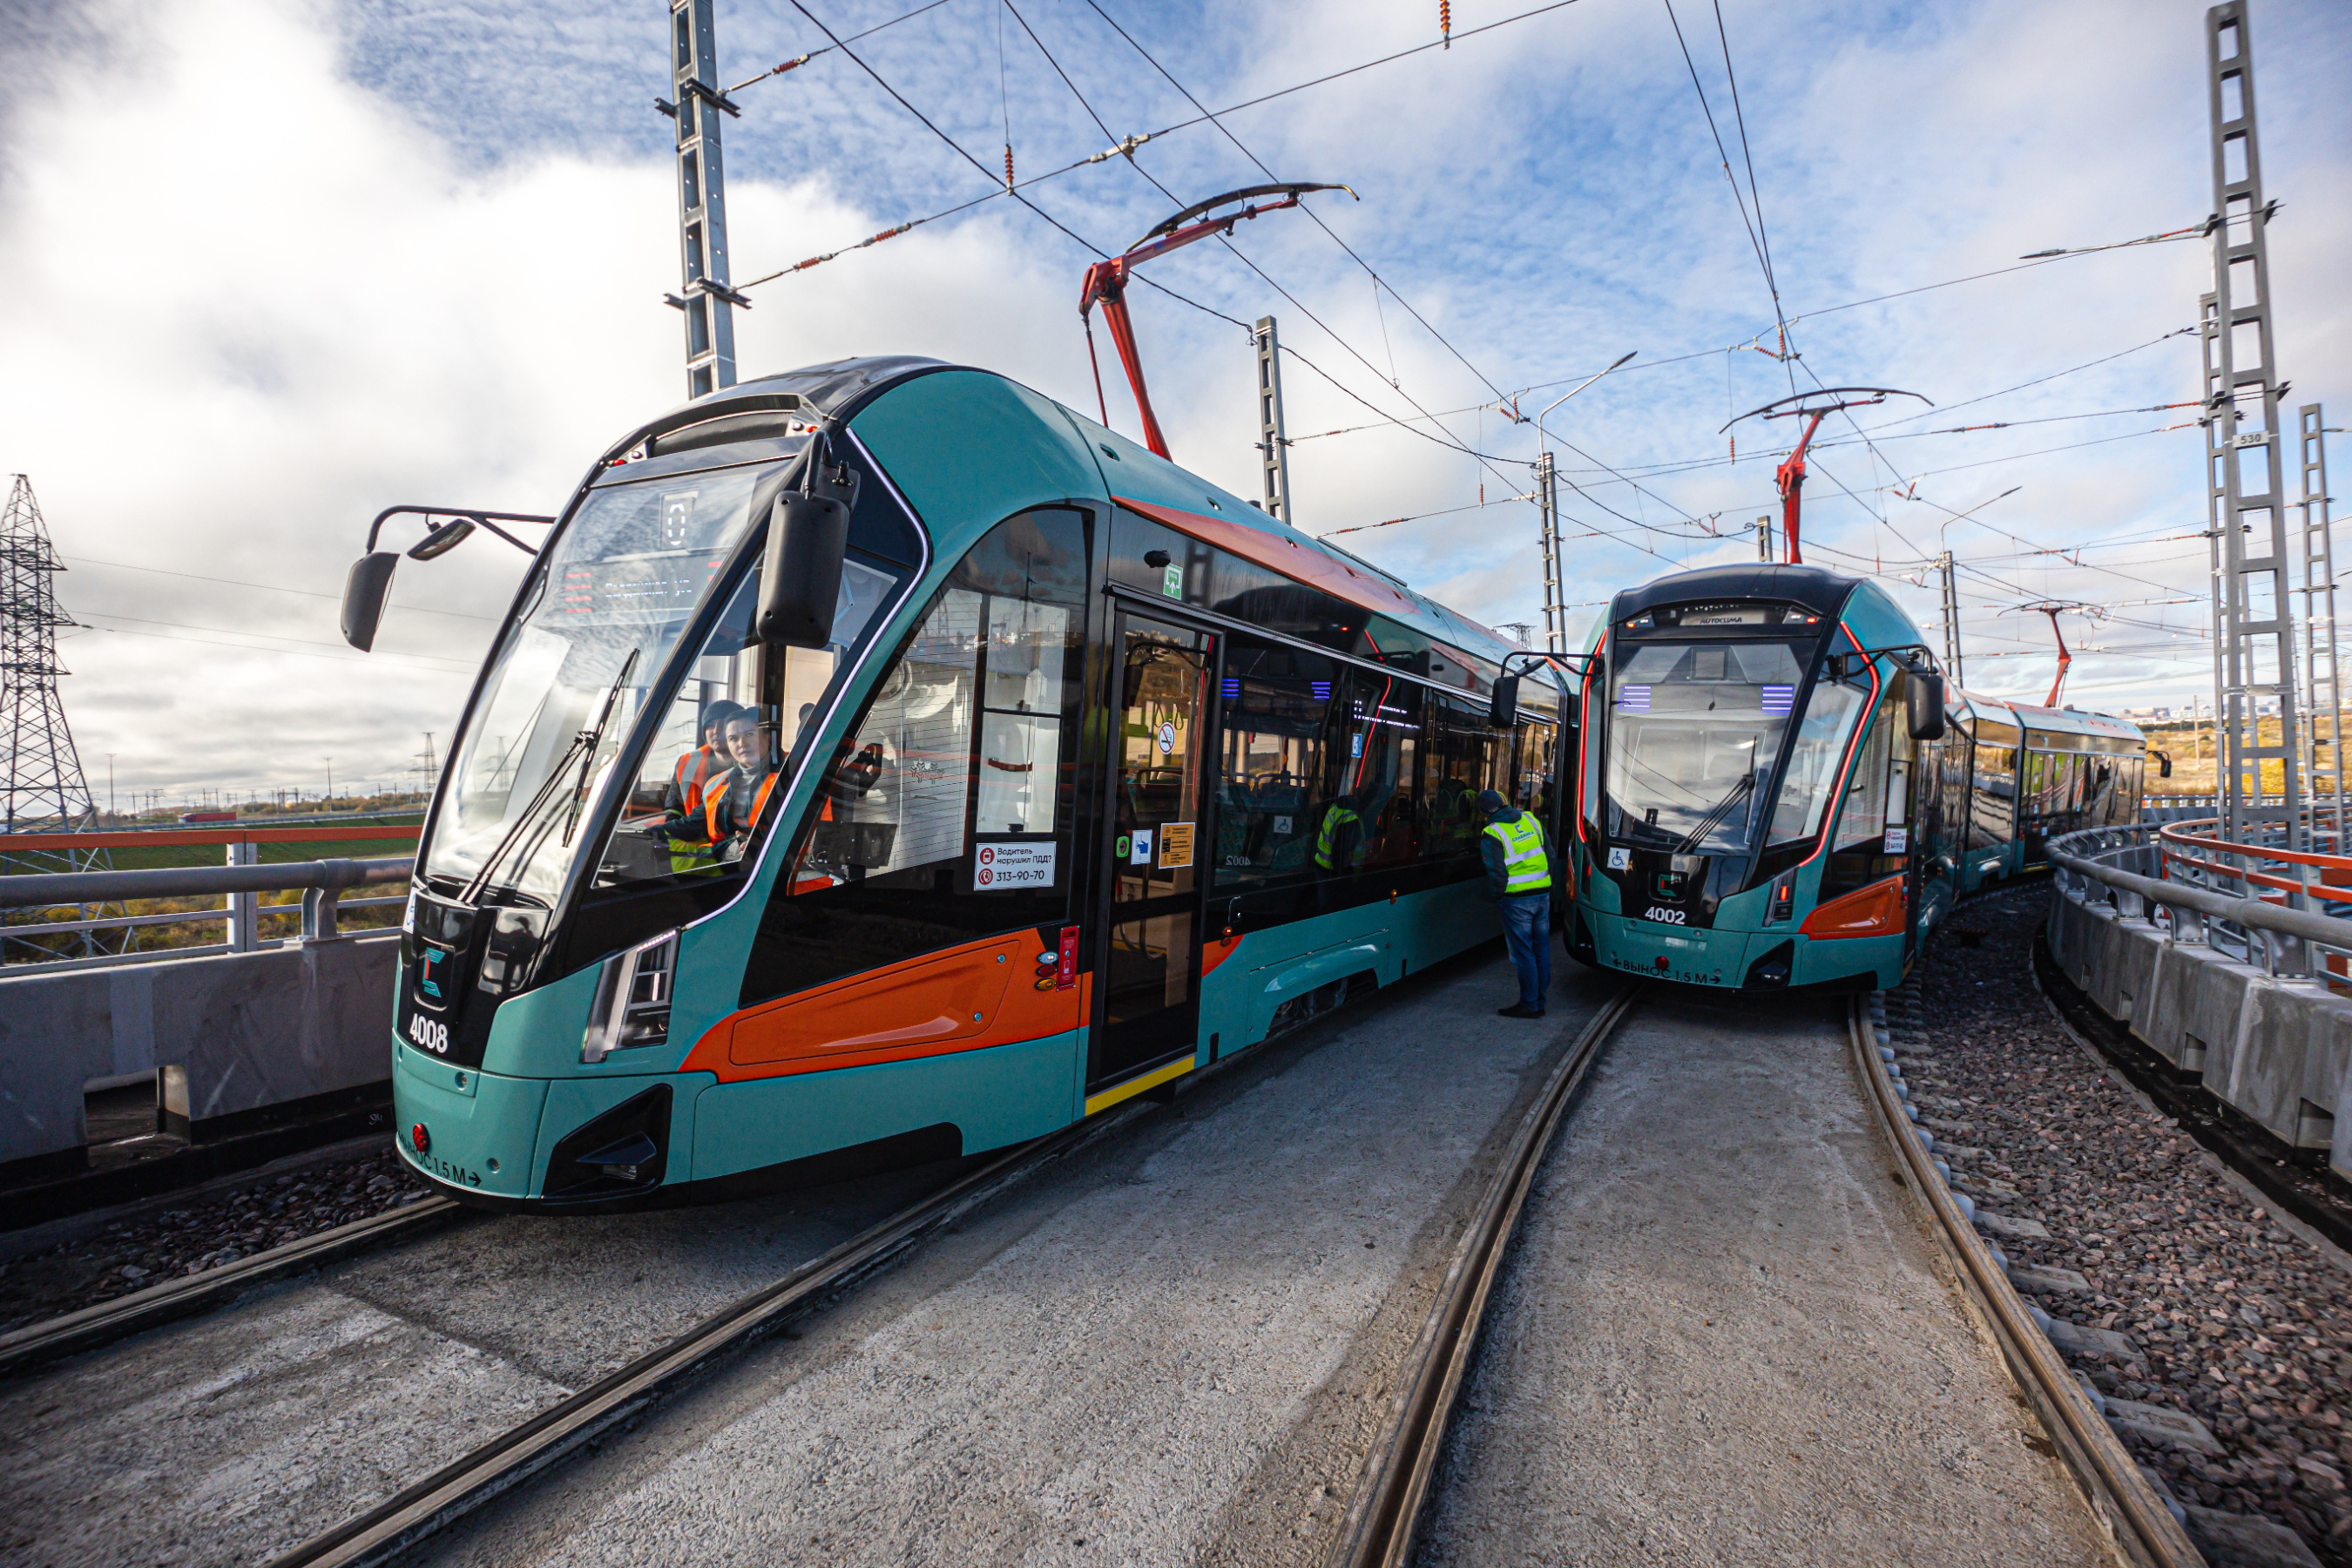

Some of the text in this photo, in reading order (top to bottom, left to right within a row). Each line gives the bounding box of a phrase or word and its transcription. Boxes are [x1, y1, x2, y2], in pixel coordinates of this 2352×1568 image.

[2240, 433, 2262, 444] 530
[997, 848, 1033, 856] Водитель
[997, 855, 1052, 866] нарушил ПДД?
[996, 869, 1044, 882] 313-90-70
[1645, 906, 1686, 925] 4002
[1623, 959, 1672, 979] ВЫНОС
[1675, 970, 1692, 983] 1.5
[409, 1012, 448, 1053] 4008
[434, 1157, 450, 1179] 1.5
